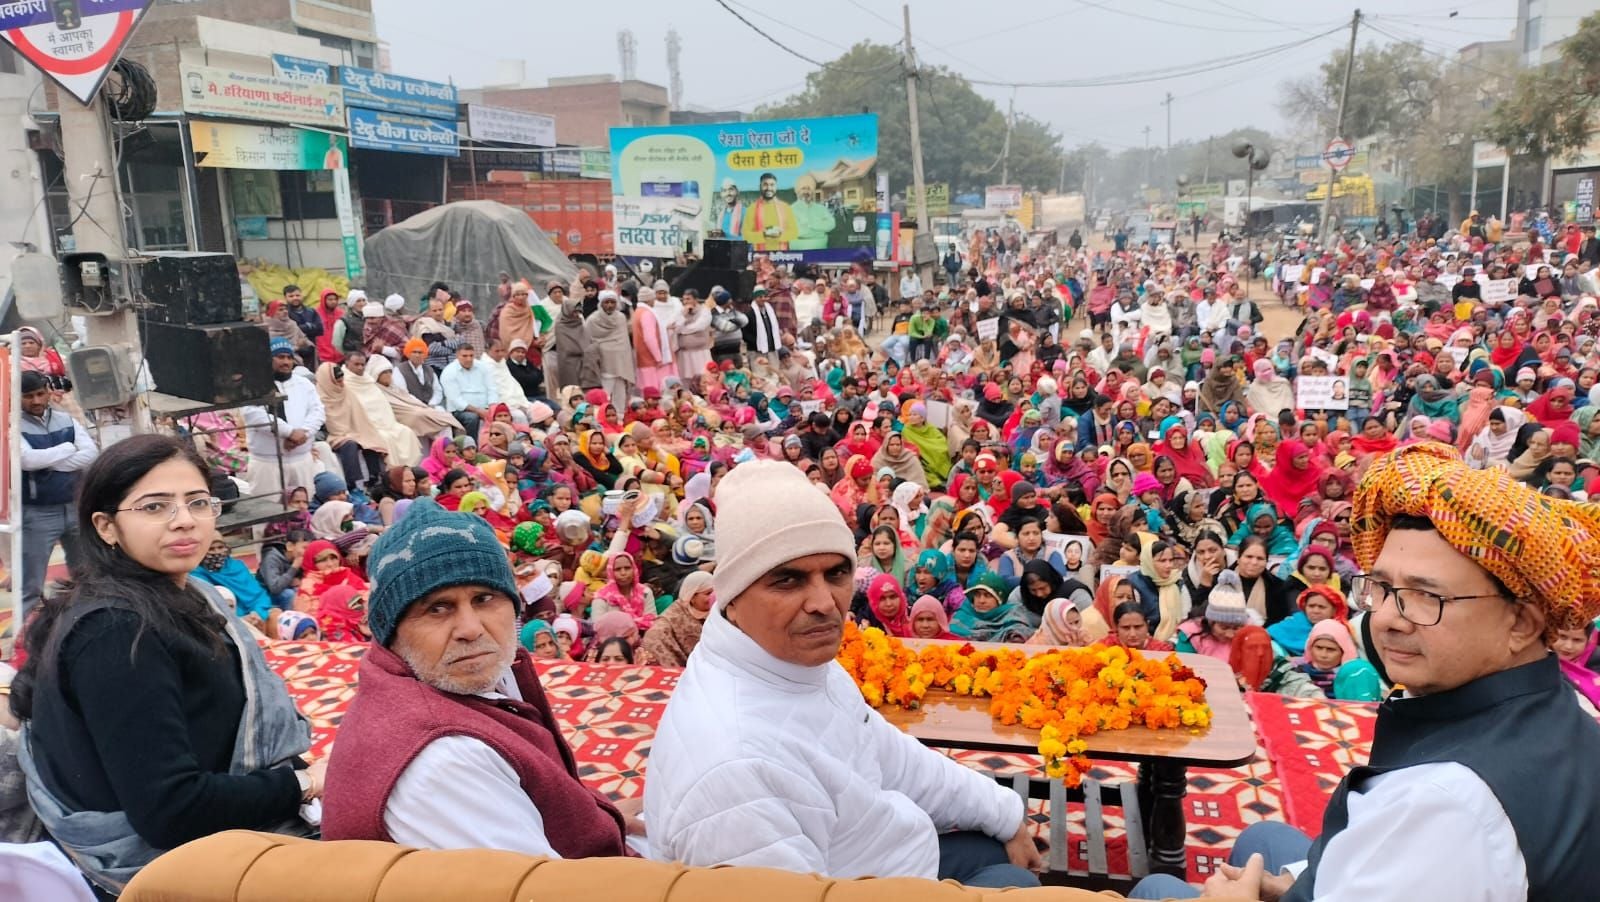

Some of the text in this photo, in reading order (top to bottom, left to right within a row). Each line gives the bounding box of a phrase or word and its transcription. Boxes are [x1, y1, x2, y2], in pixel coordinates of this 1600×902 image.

[60, 29, 93, 42] आपका
[52, 44, 83, 55] स्वागत
[748, 128, 774, 149] ऐसा
[777, 126, 797, 144] जो
[799, 124, 811, 144] दे
[732, 150, 798, 168] पैसा ही पैसा
[640, 214, 672, 225] JSW
[618, 224, 699, 247] लक्ष्य स्टी
